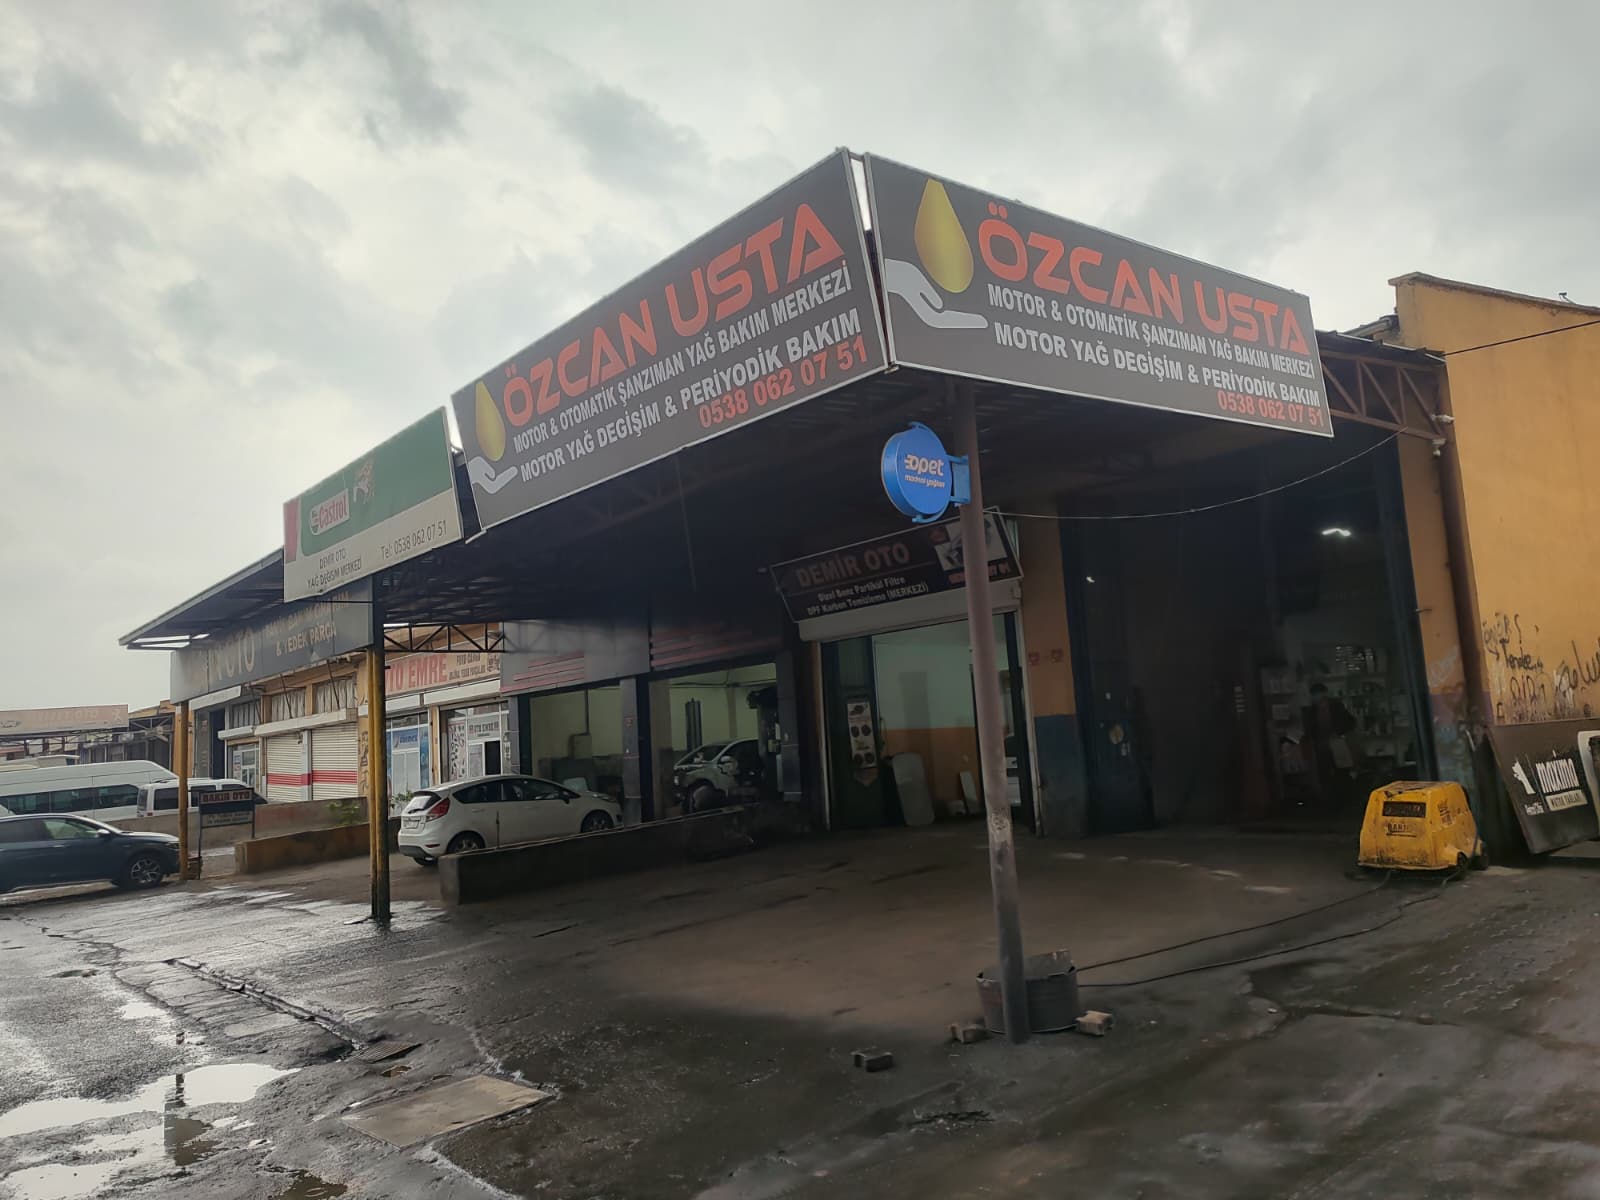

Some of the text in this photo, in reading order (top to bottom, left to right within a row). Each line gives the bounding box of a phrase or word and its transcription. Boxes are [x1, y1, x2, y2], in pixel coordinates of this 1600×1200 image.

[503, 202, 845, 427] ÖZCAN USTA
[978, 201, 1311, 356] ÖZCAN USTA
[513, 259, 852, 454] MOTOR & OTOMATİK ŞANZIMAN YAĞ BAKIM MERKEZİ
[987, 283, 1315, 379] MOTOR & OTOMATİK ŞANZIMAN YAĞ BAKIM MERKEZİ
[994, 321, 1068, 358] MOTOR
[1070, 340, 1110, 366] YAĞ
[1187, 364, 1199, 384] &
[1202, 366, 1278, 400] PERİYODİK
[1279, 383, 1320, 407] BAKIM
[520, 453, 566, 482] MOTOR
[565, 430, 595, 461] YAĞ
[664, 395, 678, 418] &
[680, 345, 784, 410] PERİYODİK
[786, 307, 861, 363] BAKIM
[699, 335, 867, 428] 0538 062 07 51
[1217, 390, 1324, 427] 0538 062 07 51
[319, 494, 347, 529] Castrol
[393, 535, 411, 555] 0538
[412, 528, 425, 547] 062
[426, 523, 436, 541] 07
[437, 520, 447, 536] 51
[796, 543, 910, 587] DEMİR OTO
[408, 653, 448, 688] EMRE
